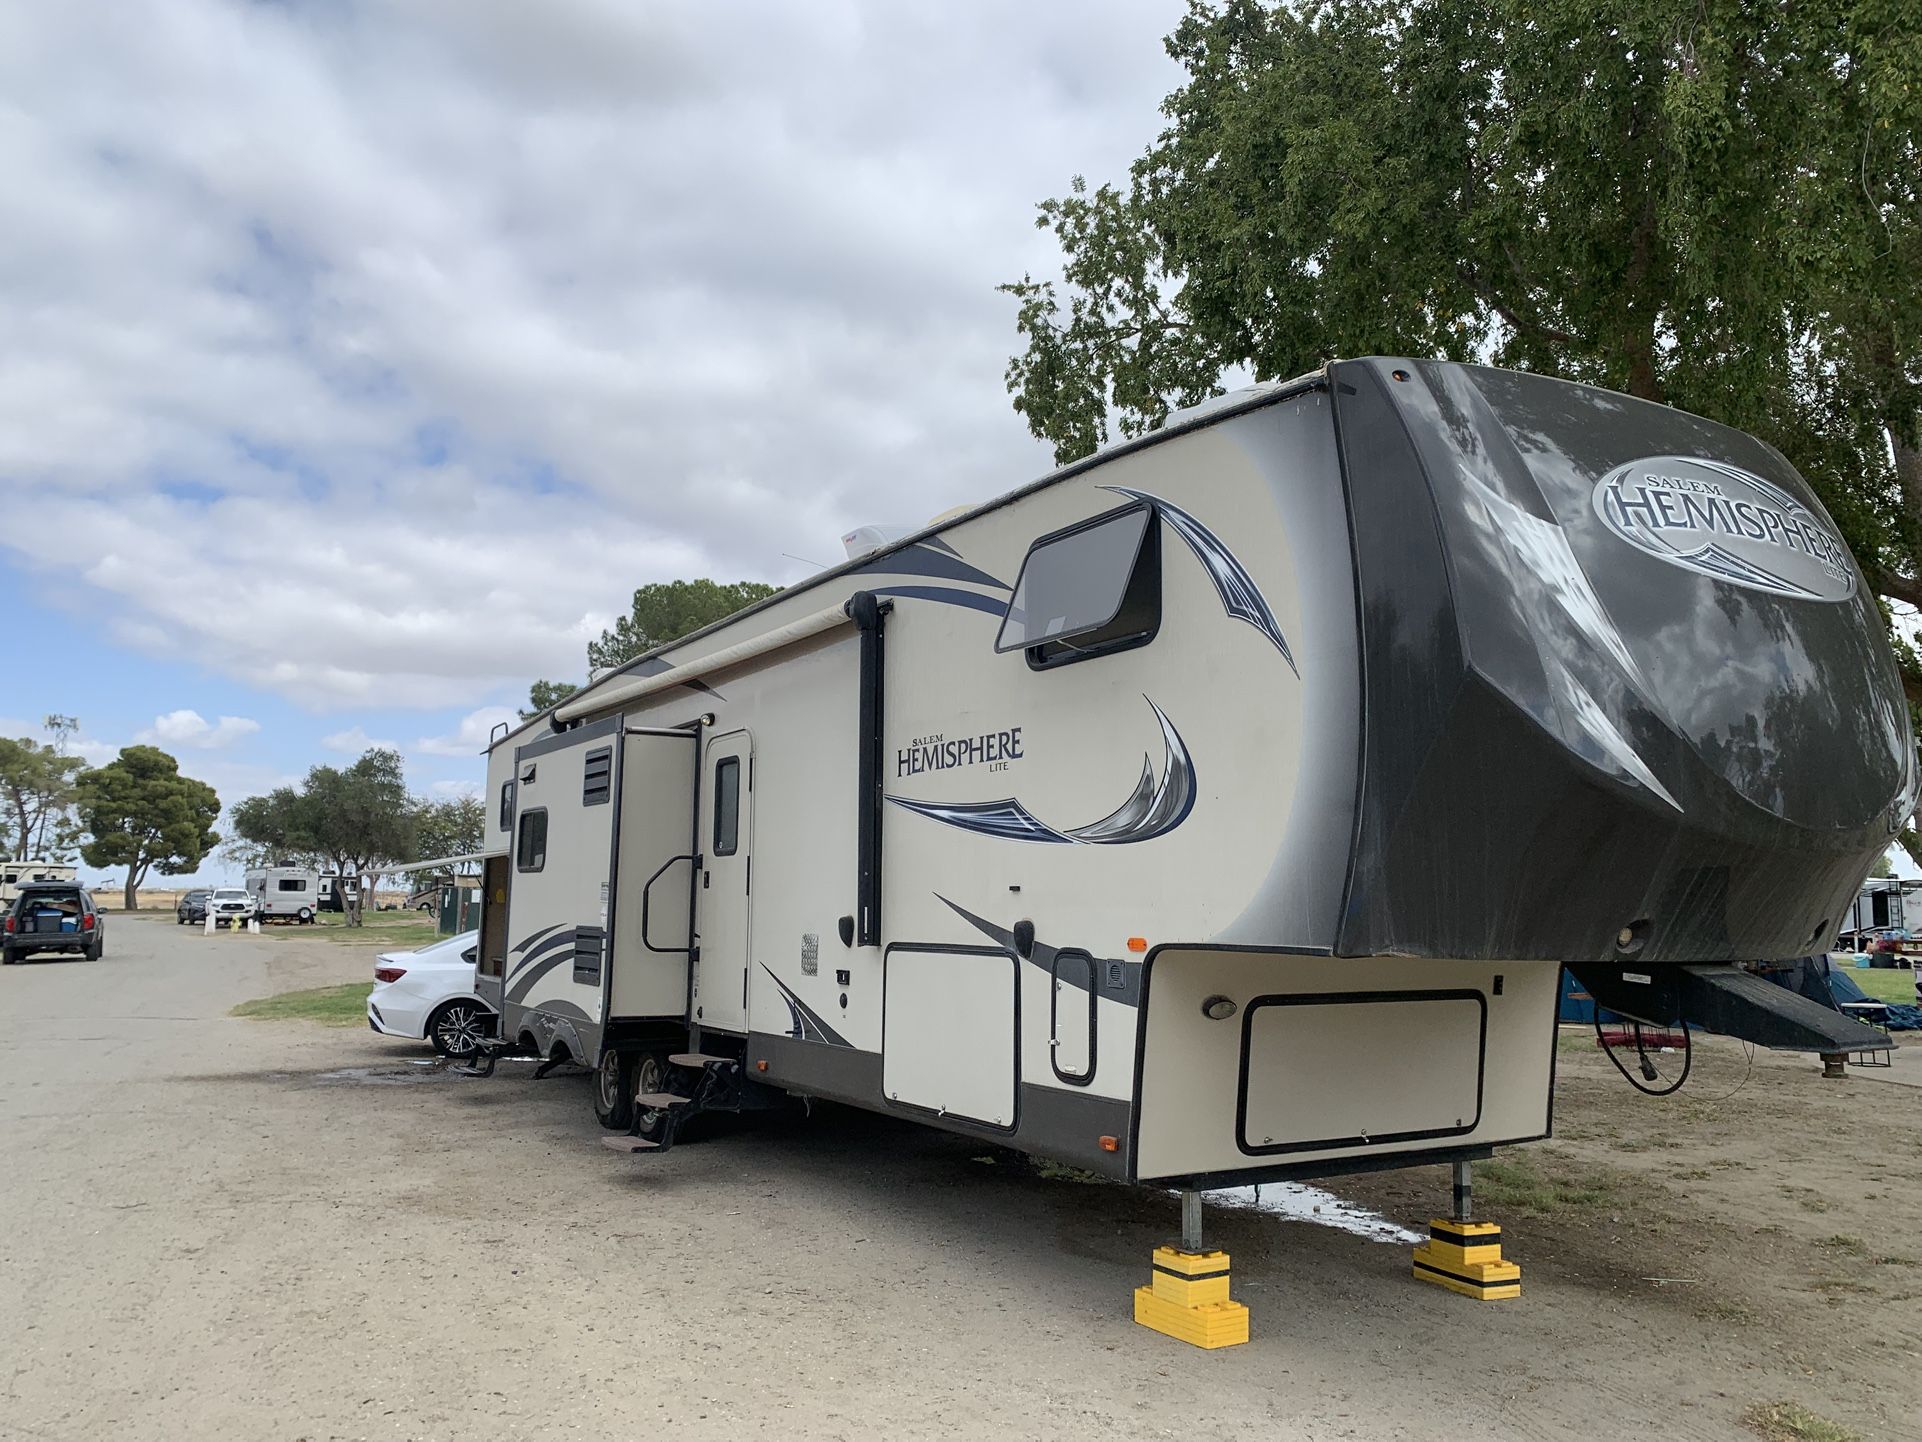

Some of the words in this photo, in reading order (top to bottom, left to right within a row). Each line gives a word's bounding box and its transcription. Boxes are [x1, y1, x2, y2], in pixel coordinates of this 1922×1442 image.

[1645, 475, 1723, 496] SALEM
[1607, 485, 1853, 577] HEMISPHERE
[912, 733, 944, 748] SALEM
[897, 726, 1024, 777] HEMISPHERE
[989, 761, 1009, 772] LITE
